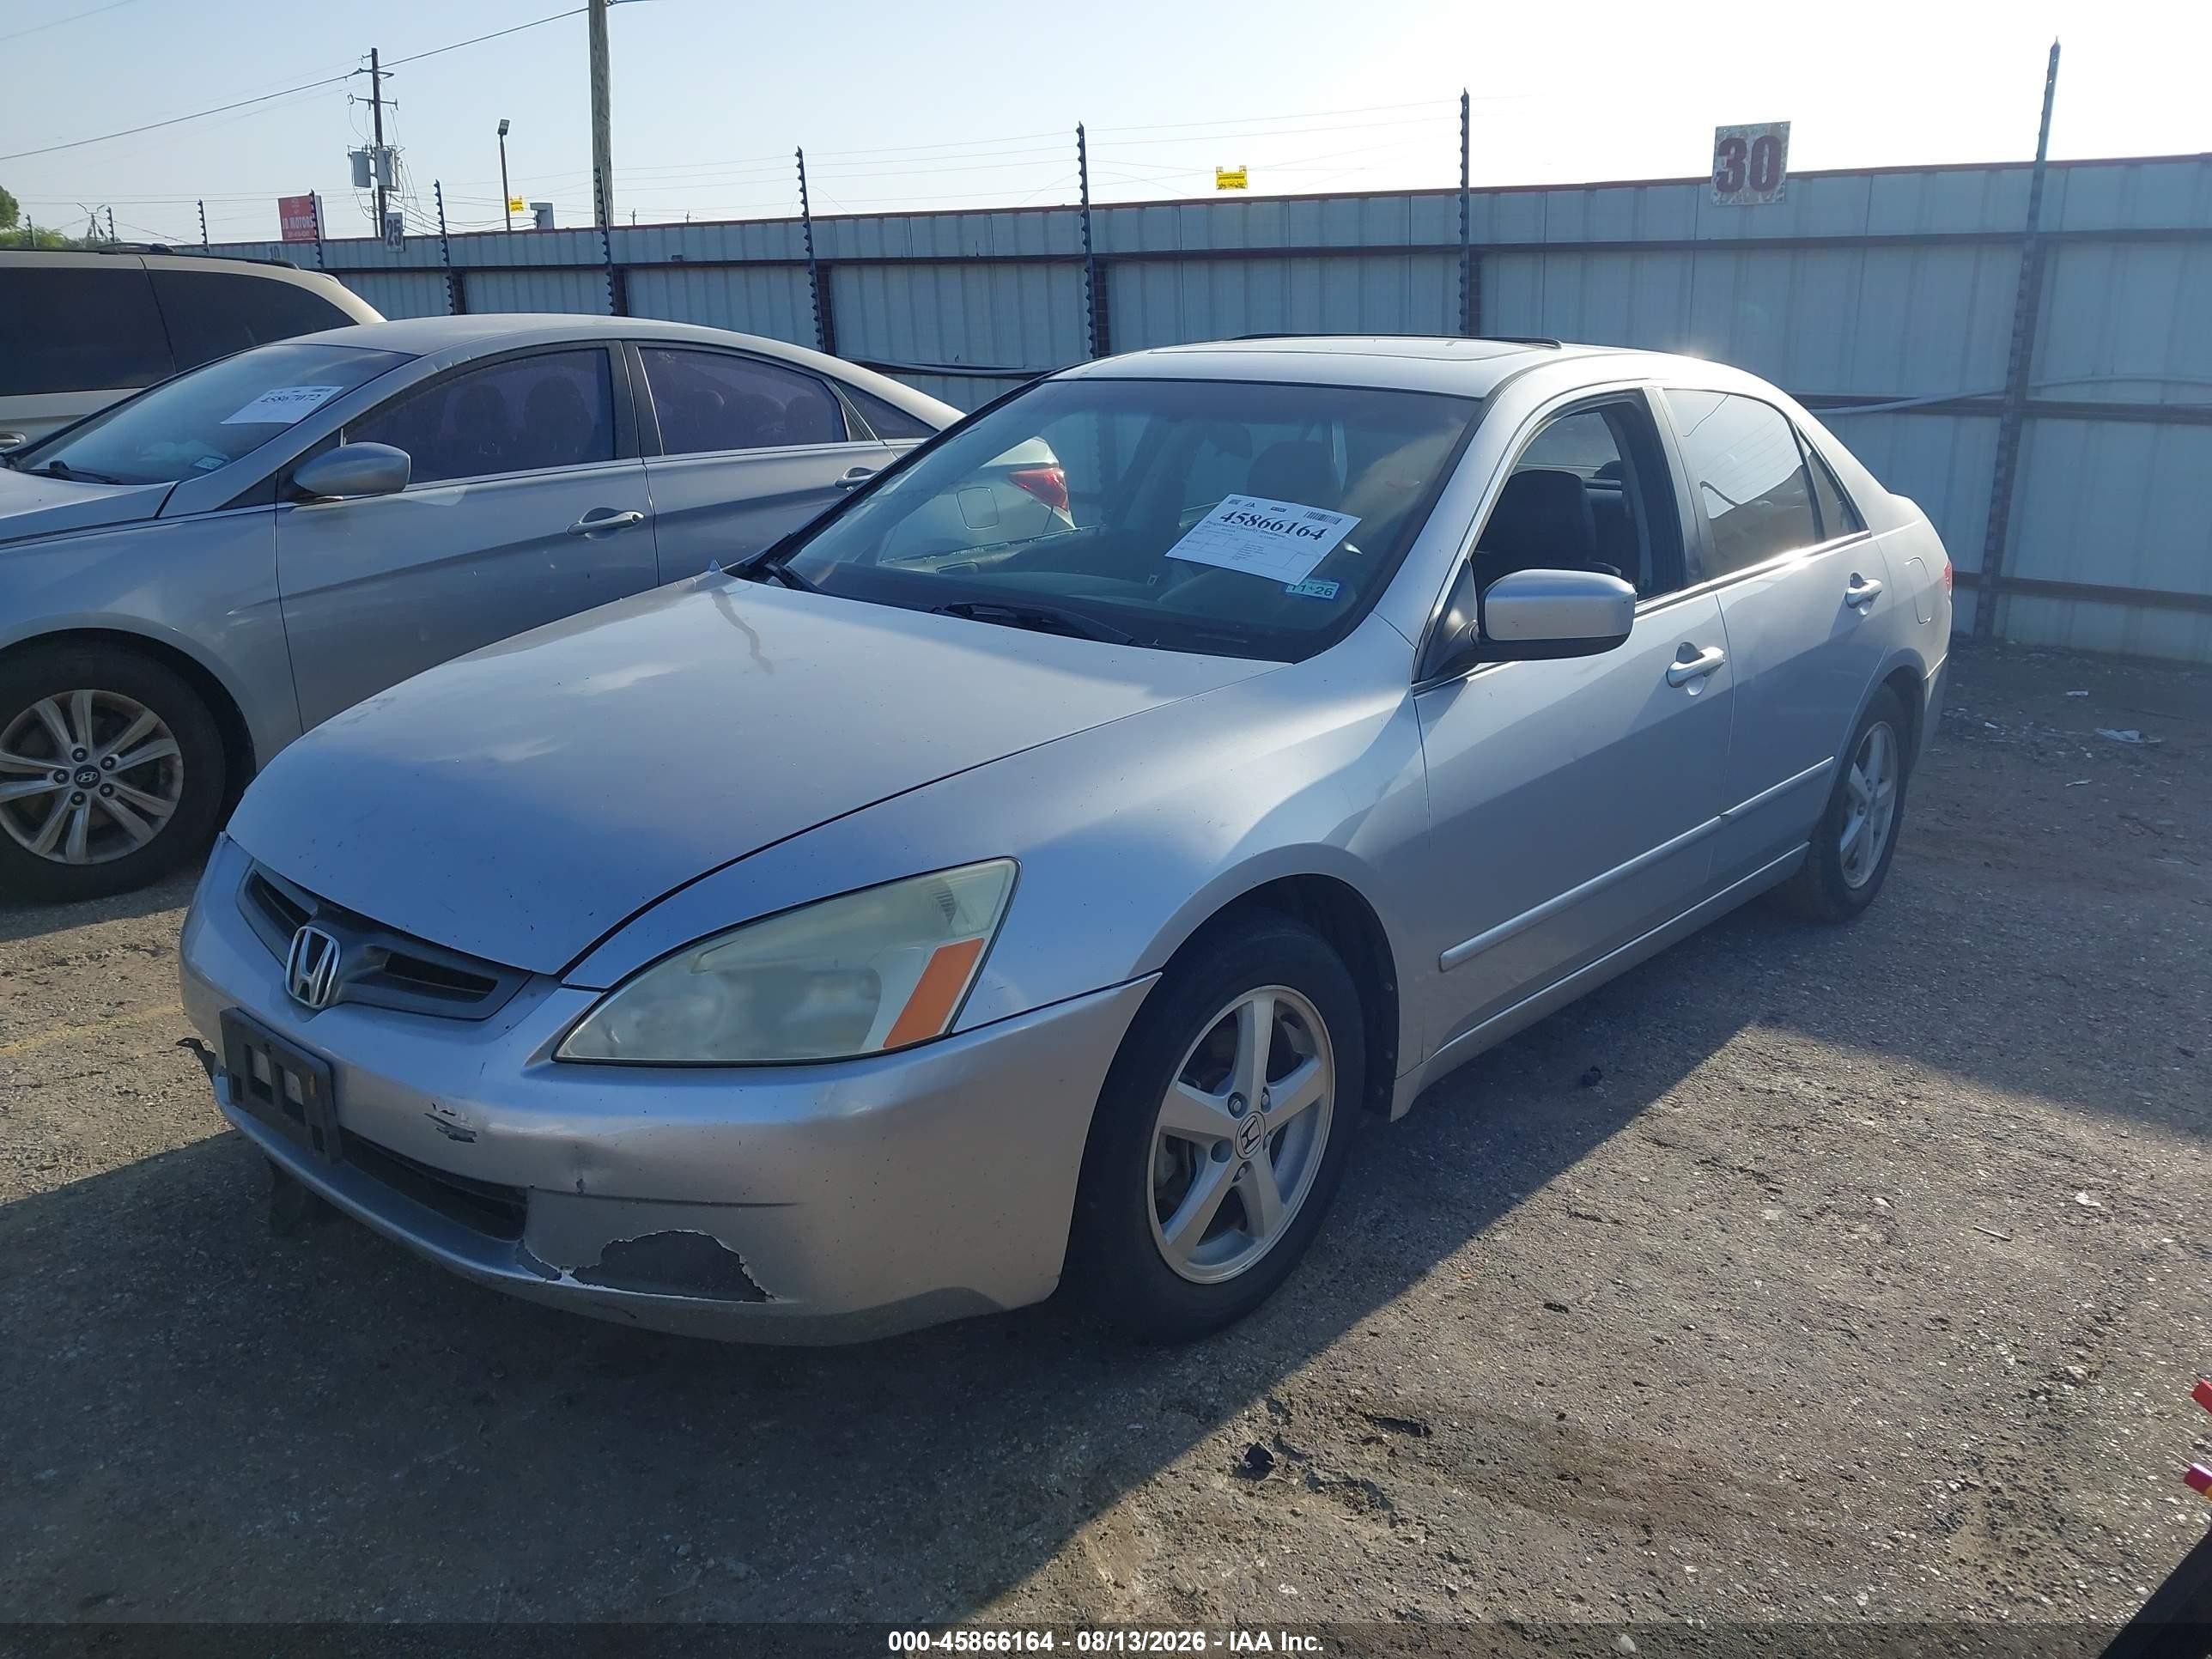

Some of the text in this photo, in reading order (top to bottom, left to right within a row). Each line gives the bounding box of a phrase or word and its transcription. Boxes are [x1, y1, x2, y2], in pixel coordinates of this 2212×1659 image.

[1716, 135, 1783, 193] 30
[289, 215, 314, 229] MOTORS
[386, 219, 402, 247] 25
[269, 246, 281, 260] 10
[1219, 510, 1328, 541] 45866164
